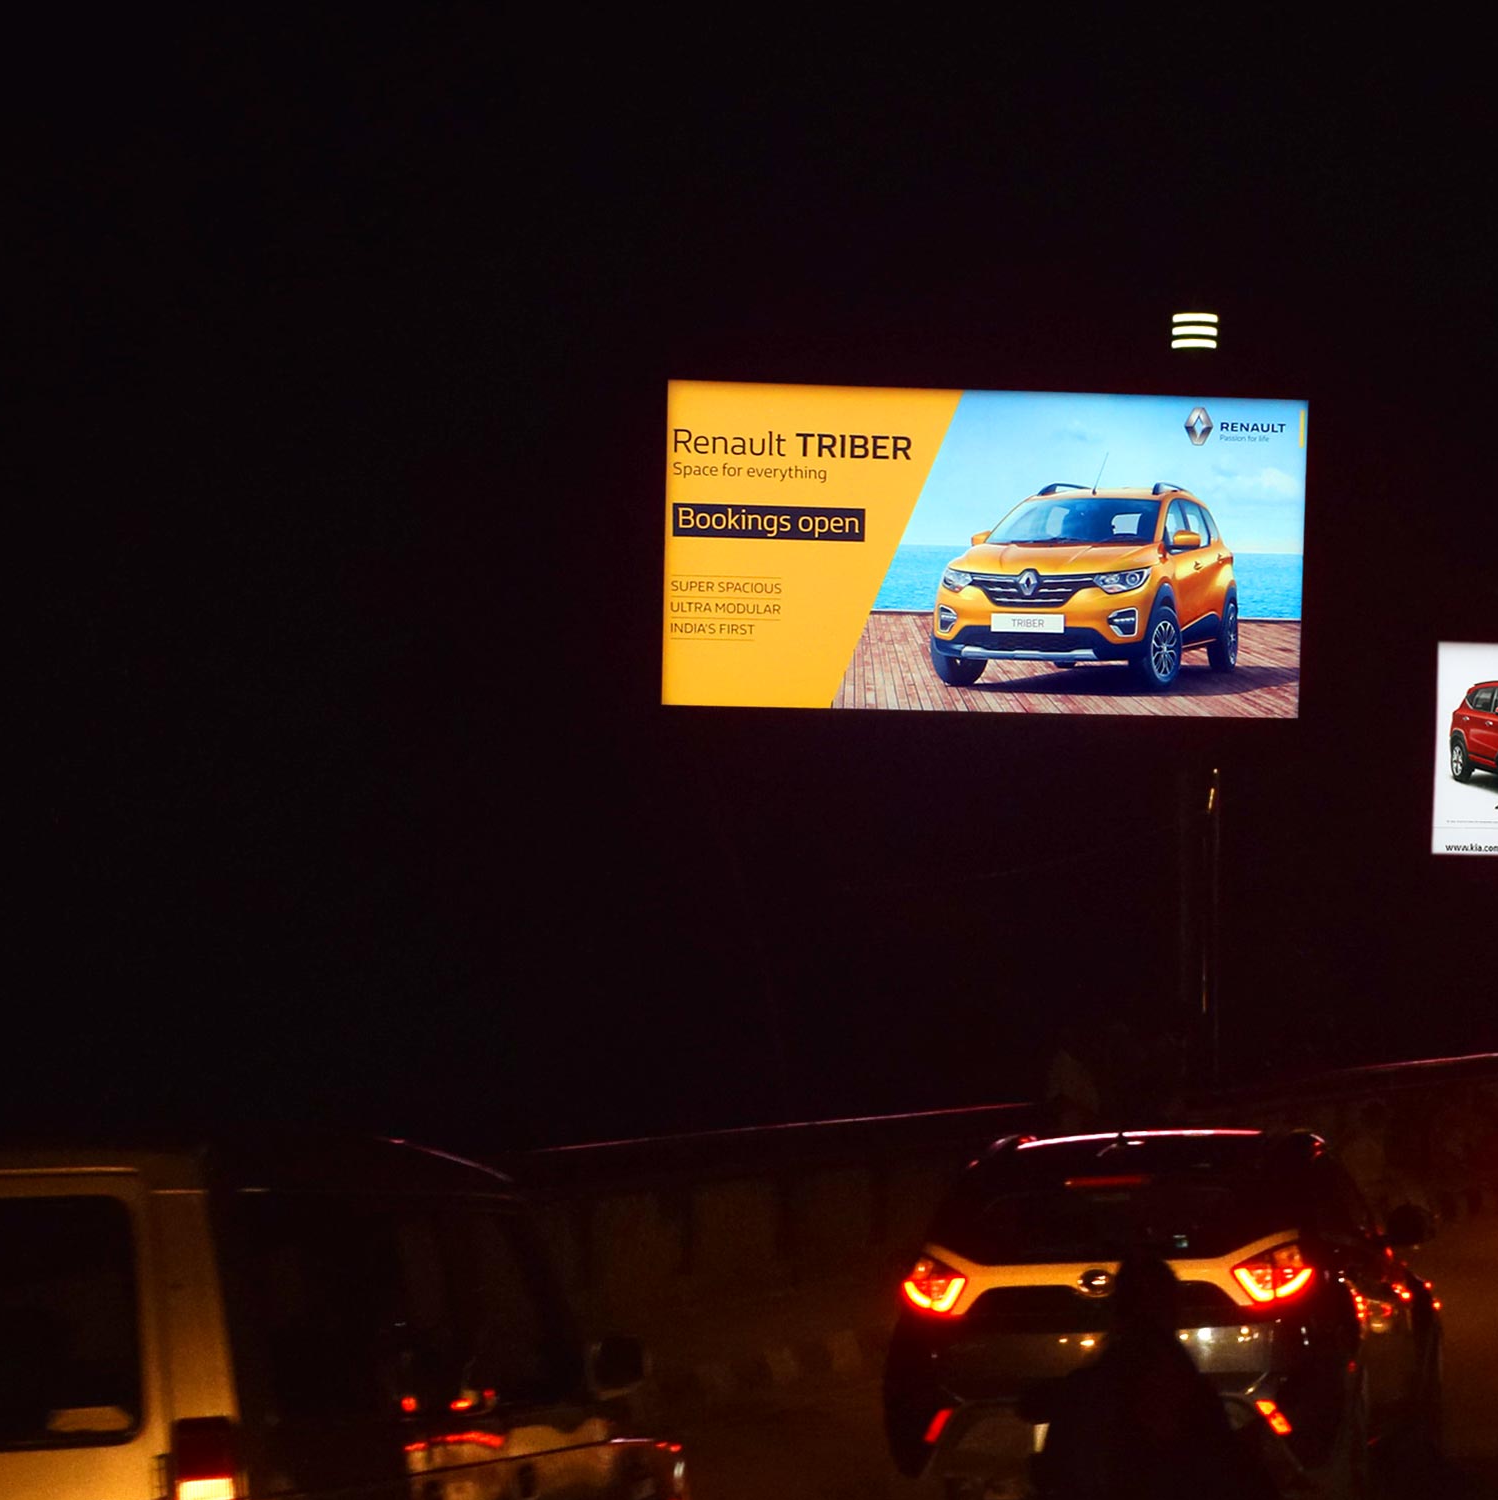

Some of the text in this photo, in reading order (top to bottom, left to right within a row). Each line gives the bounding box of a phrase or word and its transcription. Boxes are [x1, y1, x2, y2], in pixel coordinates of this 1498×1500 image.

[1220, 422, 1286, 433] RENAULT
[673, 429, 912, 460] Renault TRIBER
[673, 462, 828, 483] Space for everything
[677, 507, 860, 538] Bookings open
[671, 580, 782, 594] SUPER SPACIOUS
[670, 601, 781, 615] ULTRA MODULAR
[670, 622, 755, 635] INDIA'S FIRST
[1011, 618, 1045, 629] TRIBER
